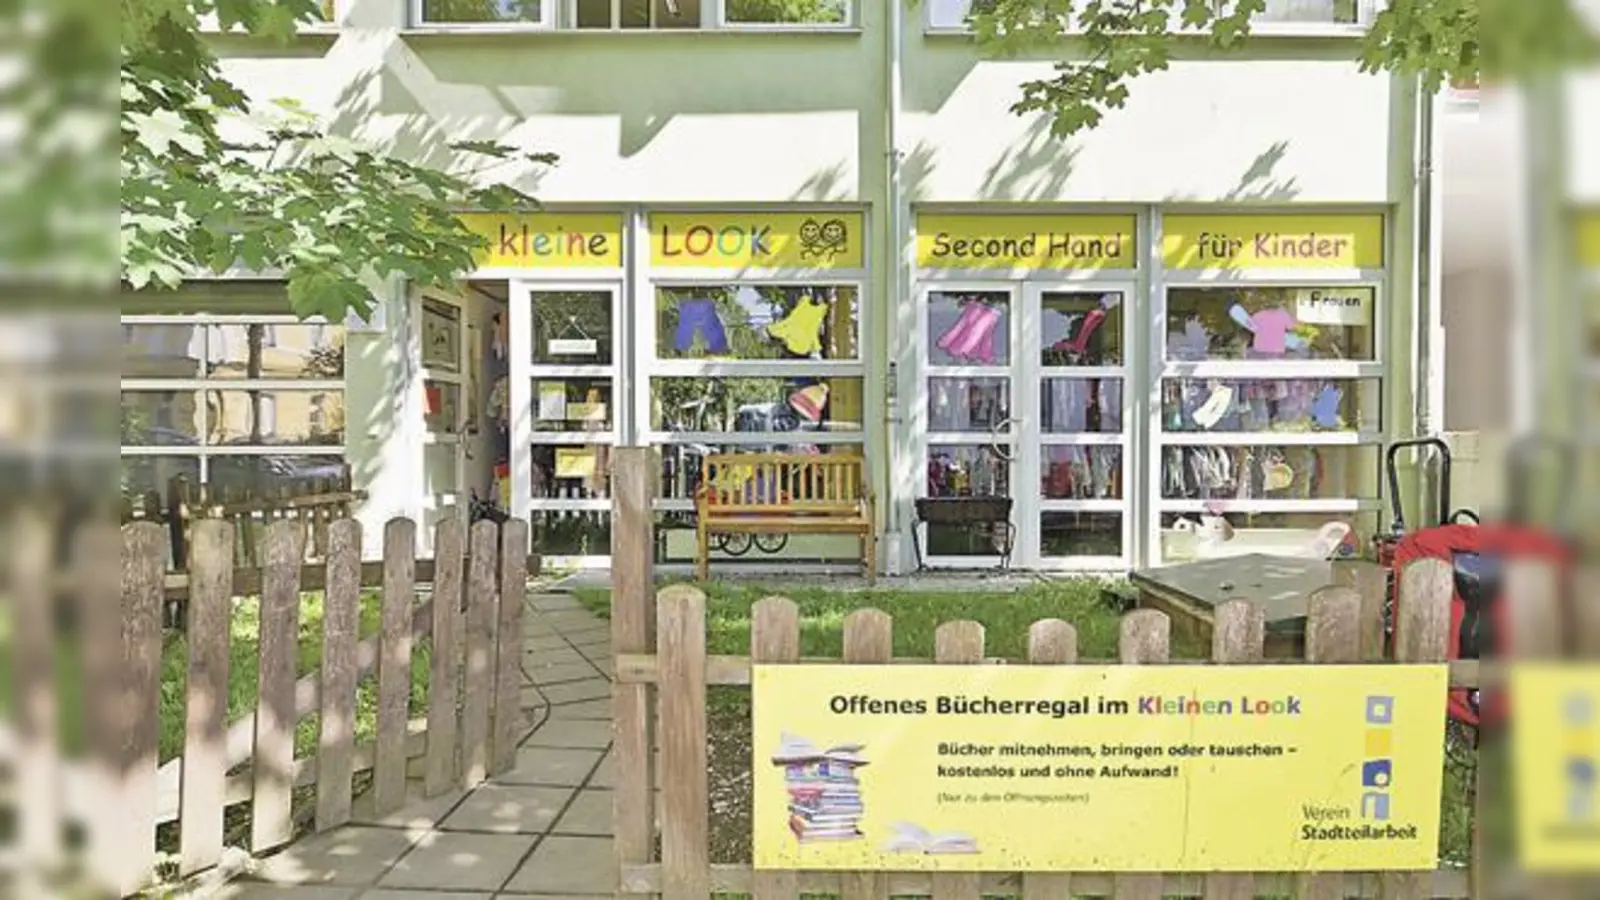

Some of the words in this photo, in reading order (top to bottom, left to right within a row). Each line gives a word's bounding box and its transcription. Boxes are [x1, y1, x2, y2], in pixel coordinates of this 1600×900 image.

[499, 224, 609, 257] kleine
[662, 224, 771, 257] LOOK
[931, 231, 1036, 258] Second
[1048, 232, 1122, 258] Hand
[1199, 231, 1242, 258] für
[1254, 232, 1348, 258] Kinder
[829, 694, 928, 715] Offenes
[936, 694, 1090, 719] Bücherregal
[1098, 694, 1129, 715] im
[1137, 694, 1233, 715] Kleinen
[1241, 694, 1301, 715] Look
[937, 743, 995, 757] Bücher
[999, 743, 1096, 759] mitnehmen,
[1100, 743, 1164, 760] bringen
[1167, 743, 1206, 757] oder
[1209, 743, 1284, 757] tauschen
[937, 764, 1016, 779] kostenlos
[1019, 764, 1052, 779] und
[1054, 764, 1097, 779] ohne
[1099, 764, 1180, 779] Aufwand!
[1302, 804, 1352, 821] Verein
[1301, 824, 1418, 841] Stadtteilarbeit
